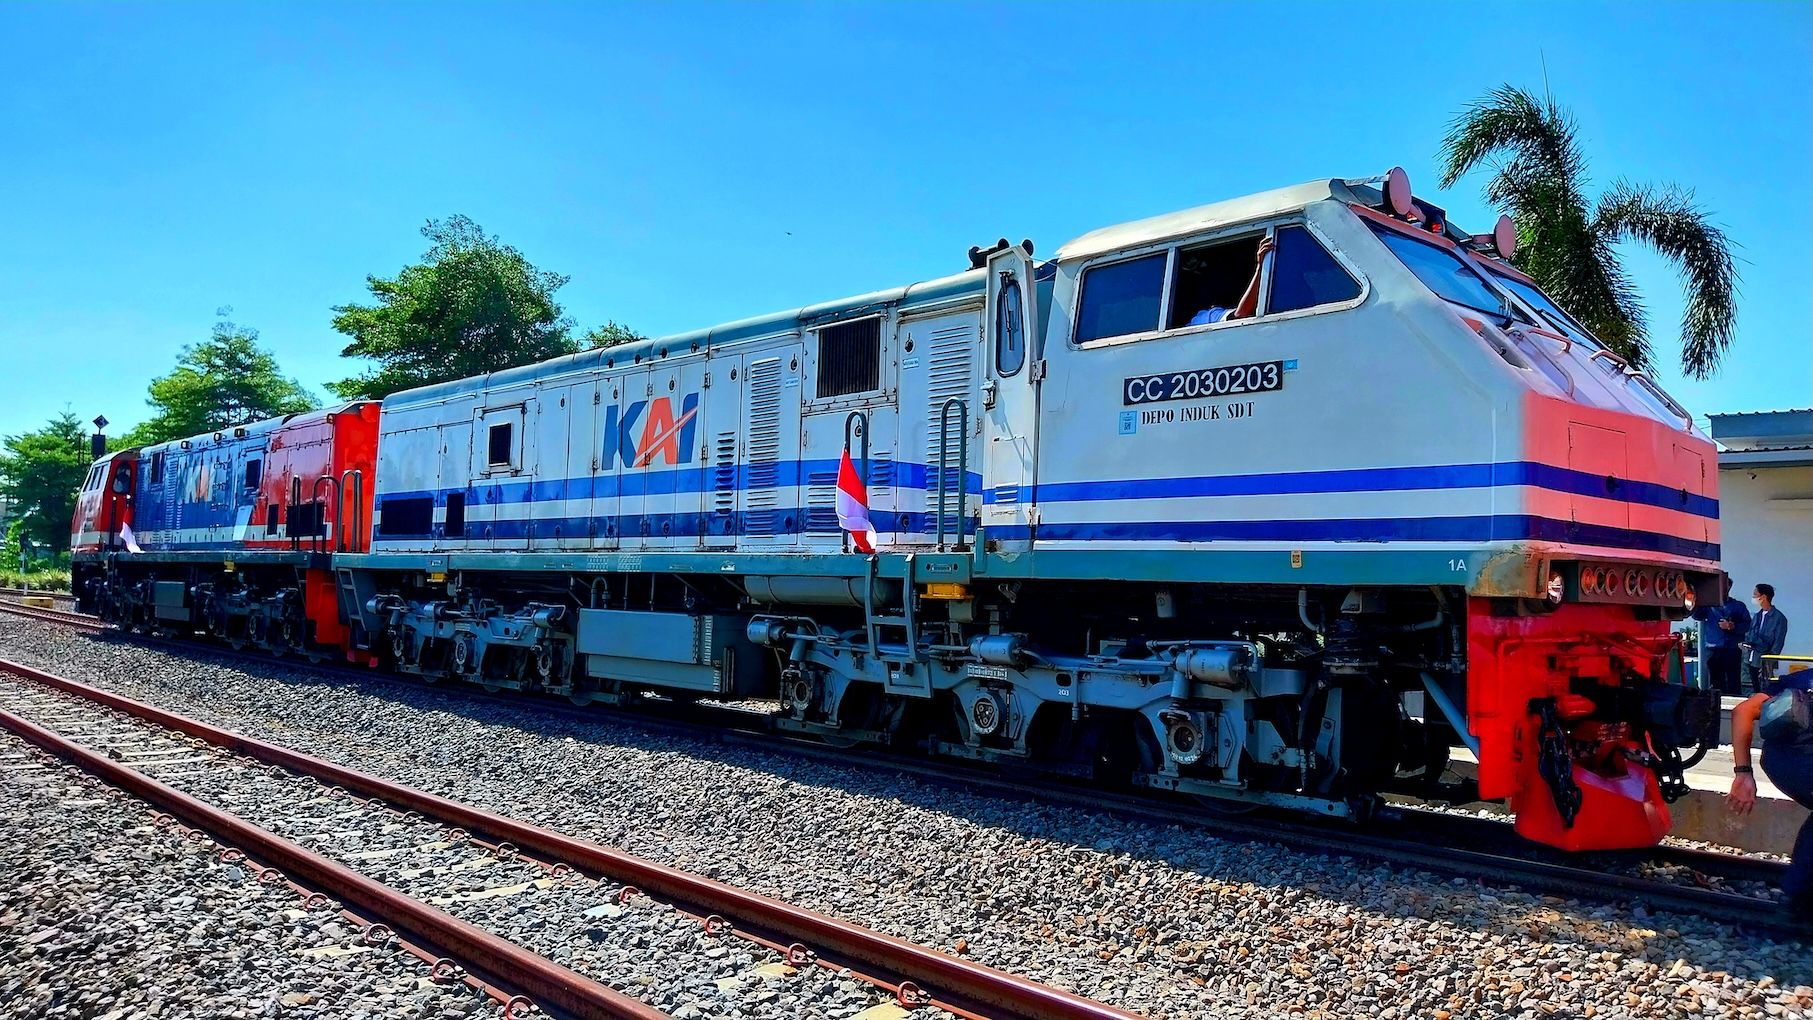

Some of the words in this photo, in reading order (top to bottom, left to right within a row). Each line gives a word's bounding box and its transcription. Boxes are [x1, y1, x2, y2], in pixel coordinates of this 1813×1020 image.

[1127, 377, 1164, 402] CC
[1170, 363, 1279, 399] 2030203
[1142, 409, 1174, 425] DEPO
[1180, 405, 1220, 422] INDUK
[1227, 402, 1255, 419] SDT
[602, 392, 699, 471] KAI
[1448, 559, 1467, 571] 1A
